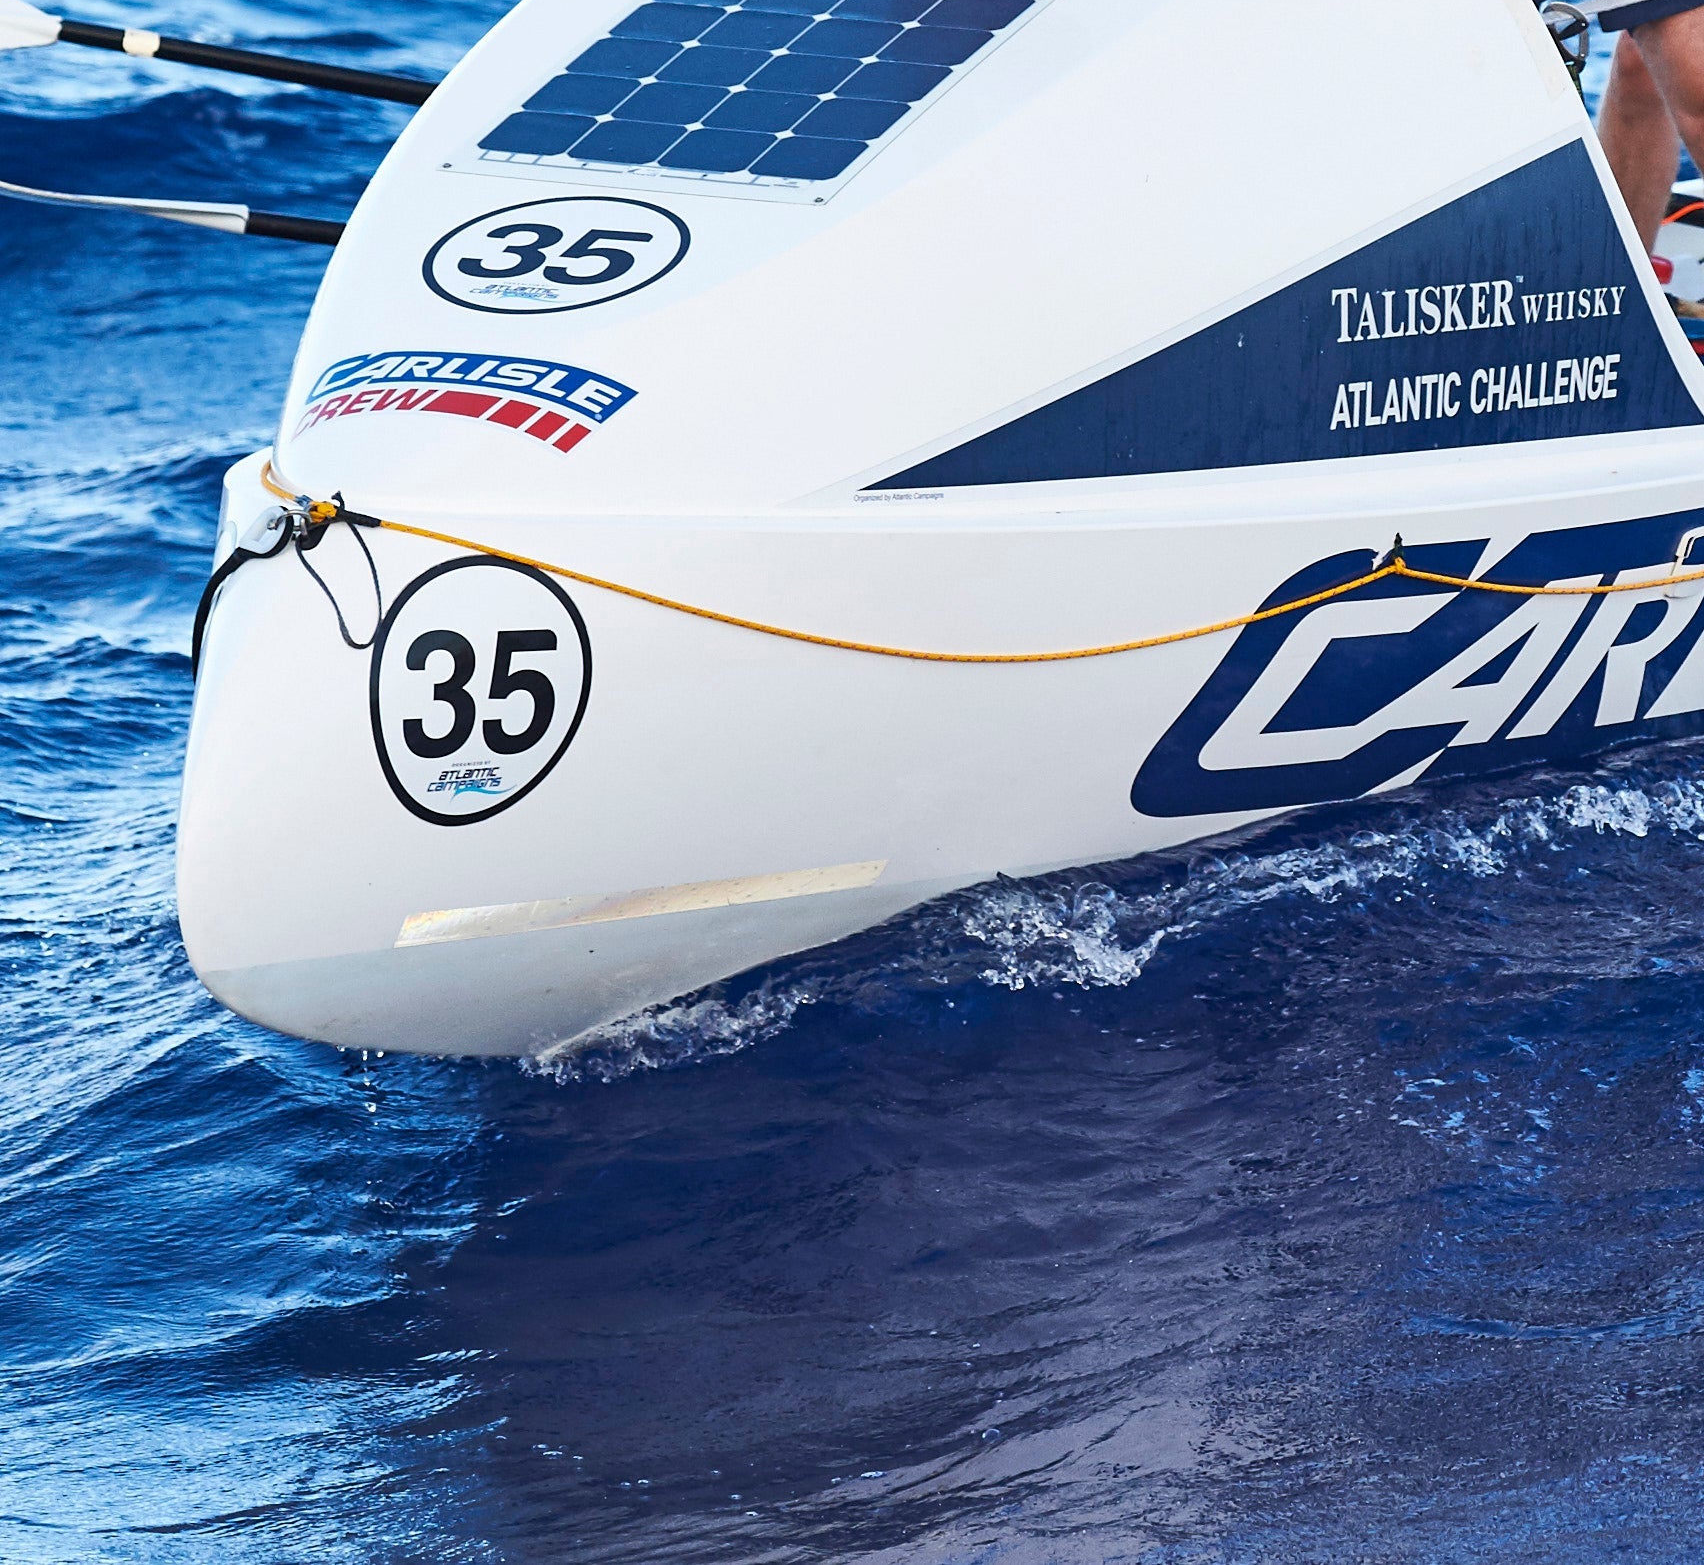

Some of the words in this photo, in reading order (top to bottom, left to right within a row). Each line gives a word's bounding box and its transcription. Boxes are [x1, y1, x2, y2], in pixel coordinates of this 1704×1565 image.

[457, 223, 653, 286] 35
[1331, 279, 1516, 344] TALISKER
[1521, 285, 1626, 324] WHISKY
[291, 388, 438, 443] CREW
[311, 355, 622, 414] CARLISLE
[1329, 371, 1462, 431] ATLANTIC
[1470, 353, 1620, 415] CHALLENGE
[403, 629, 557, 758] 35
